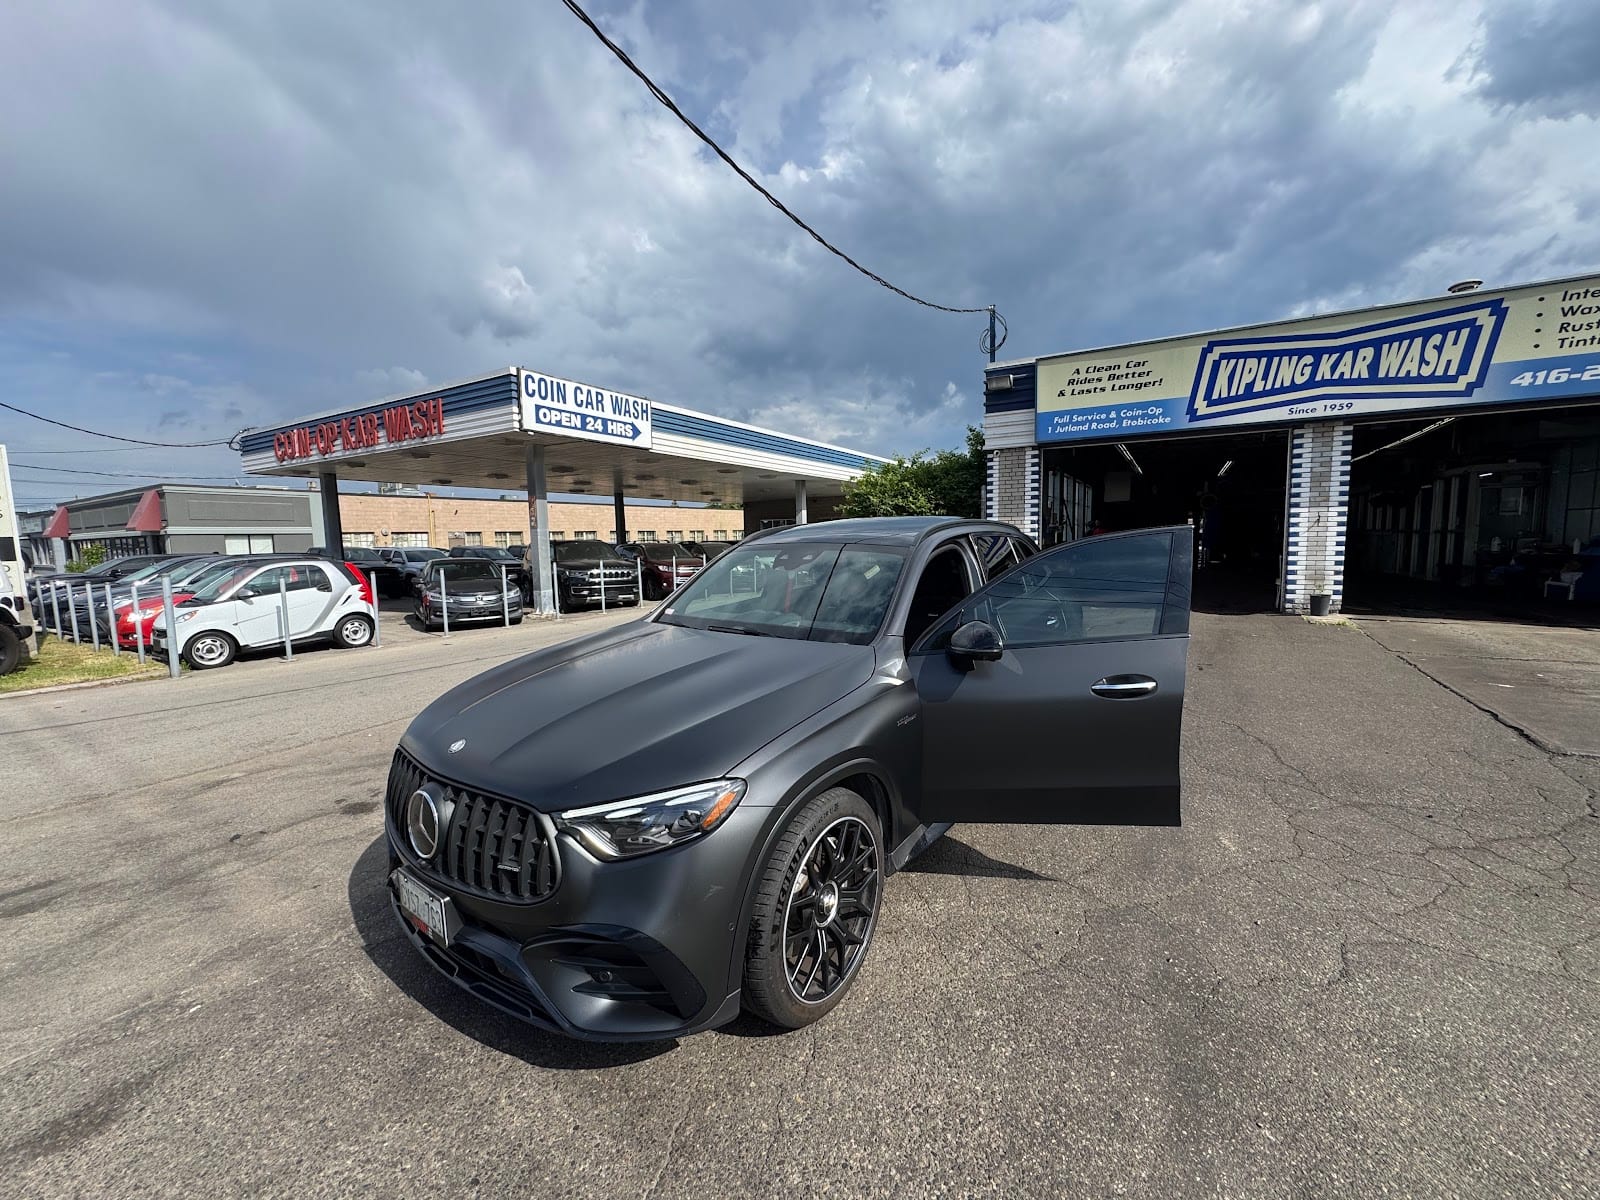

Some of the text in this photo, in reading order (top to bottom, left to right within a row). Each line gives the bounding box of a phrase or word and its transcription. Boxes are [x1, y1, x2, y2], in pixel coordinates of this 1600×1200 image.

[1085, 364, 1121, 374] Clean
[1126, 360, 1149, 368] Car
[1211, 326, 1471, 400] KIPLING KAR WASH
[1067, 370, 1153, 386] Rides Better
[1057, 378, 1163, 397] & Lasts Longer!
[524, 374, 649, 421] COIN CAR WASH
[1053, 406, 1163, 424] Full Service & Coin-Op
[1287, 402, 1354, 415] Since 1959
[274, 398, 445, 463] COIN-OP KAR WASH
[539, 408, 634, 437] OPEN 24 HRS
[1055, 422, 1089, 433] Jutland
[1091, 420, 1119, 430] Road,
[1122, 416, 1171, 427] Etobicoke
